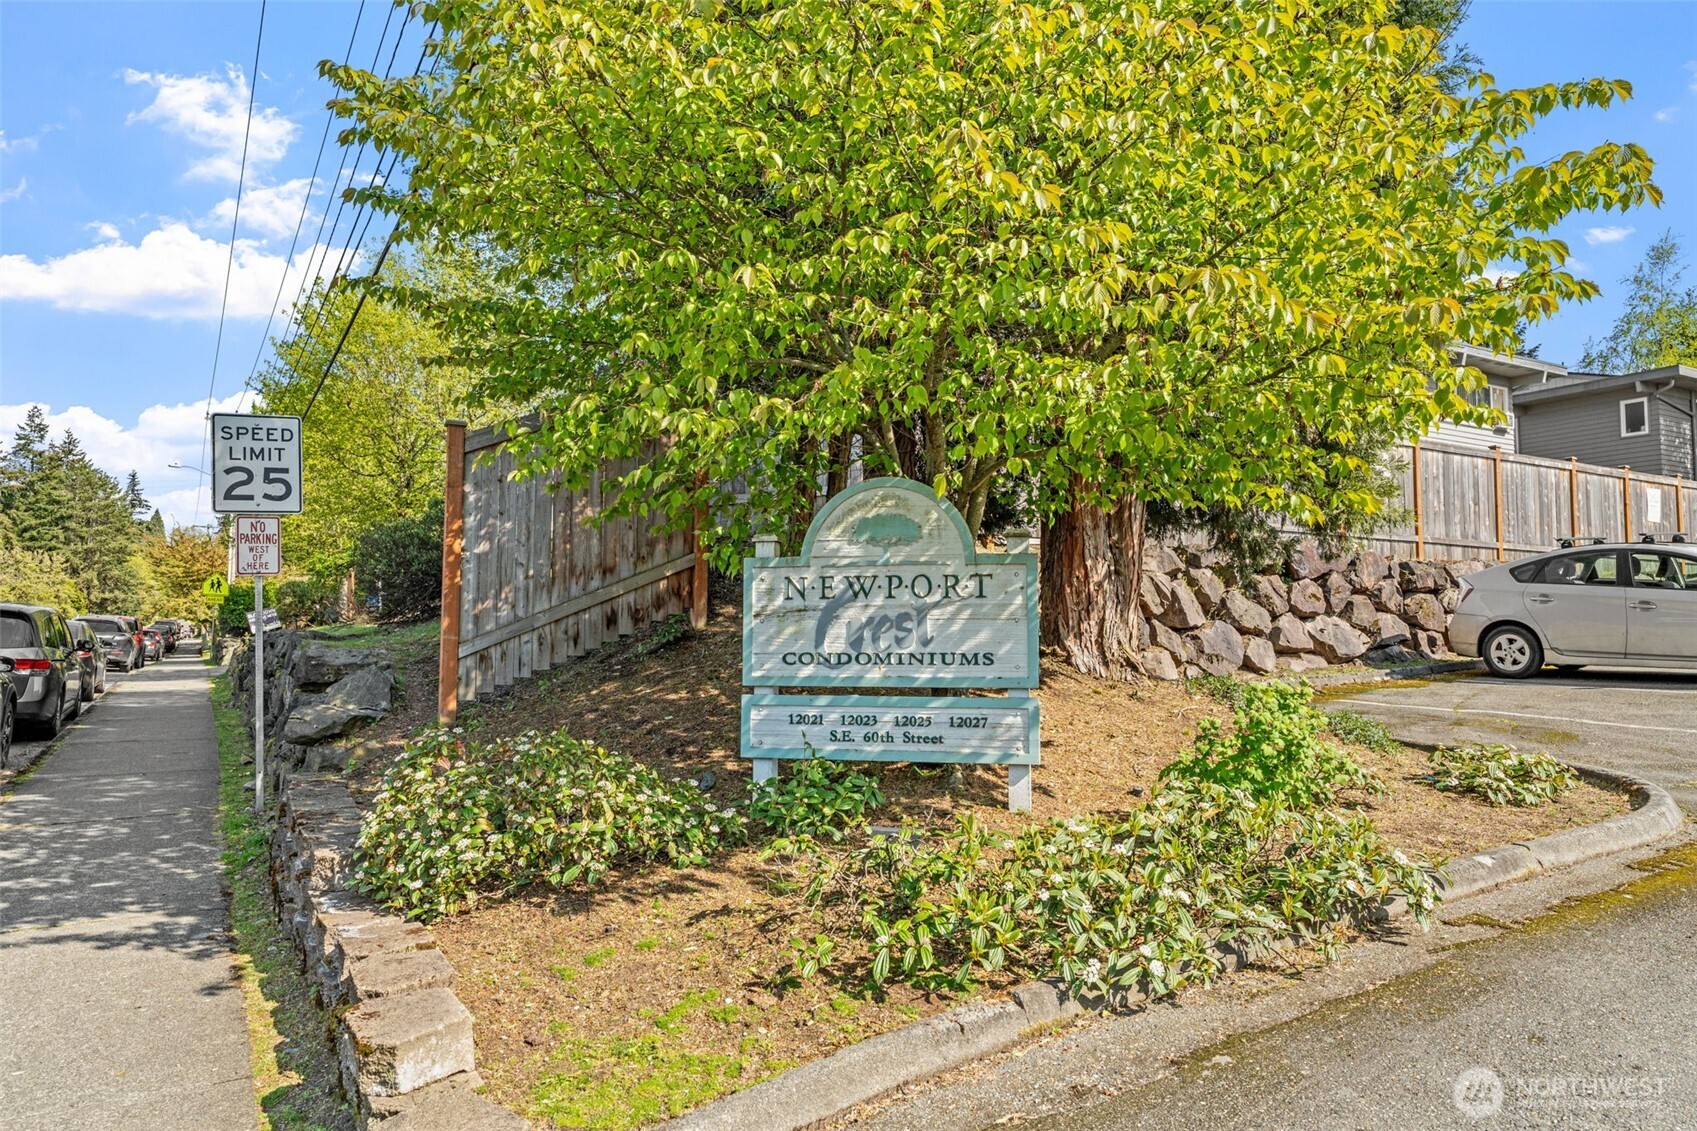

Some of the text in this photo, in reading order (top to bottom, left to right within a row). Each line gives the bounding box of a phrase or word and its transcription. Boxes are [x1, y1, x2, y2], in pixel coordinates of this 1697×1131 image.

[220, 425, 294, 442] SPEED
[229, 446, 286, 461] LIMIT
[223, 466, 293, 502] 25
[250, 521, 266, 533] NO
[240, 533, 278, 545] PARKING
[248, 545, 270, 554] WEST
[252, 554, 264, 562] OF
[247, 562, 270, 570] HERE
[815, 579, 974, 669] Crest
[781, 651, 995, 667] CONDOMINIUMS
[788, 713, 989, 728] 12021 12023 12025 12027
[829, 729, 945, 744] S.E. 60th Street
